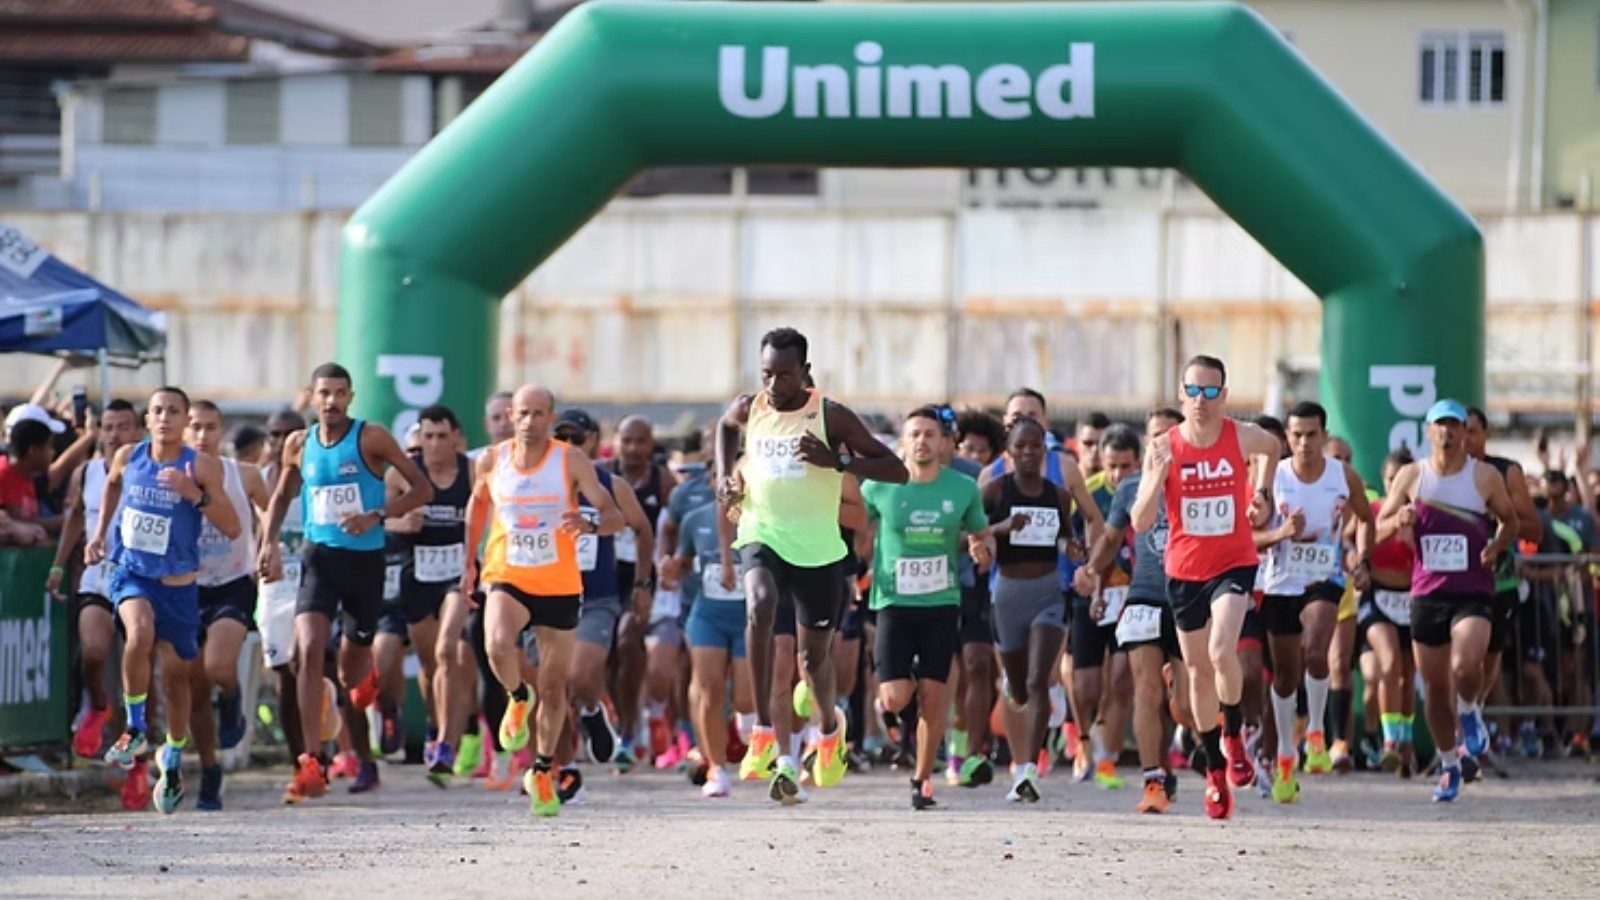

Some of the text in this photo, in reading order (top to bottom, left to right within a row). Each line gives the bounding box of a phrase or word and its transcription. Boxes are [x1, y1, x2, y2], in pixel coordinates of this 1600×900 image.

[717, 41, 1096, 120] Unimed
[1181, 457, 1234, 481] FILA
[1186, 500, 1228, 519] 610
[512, 533, 549, 550] 496
[1423, 538, 1464, 553] 1725
[418, 549, 459, 563] 1711
[1290, 546, 1330, 564] 395
[900, 559, 942, 576] 1931
